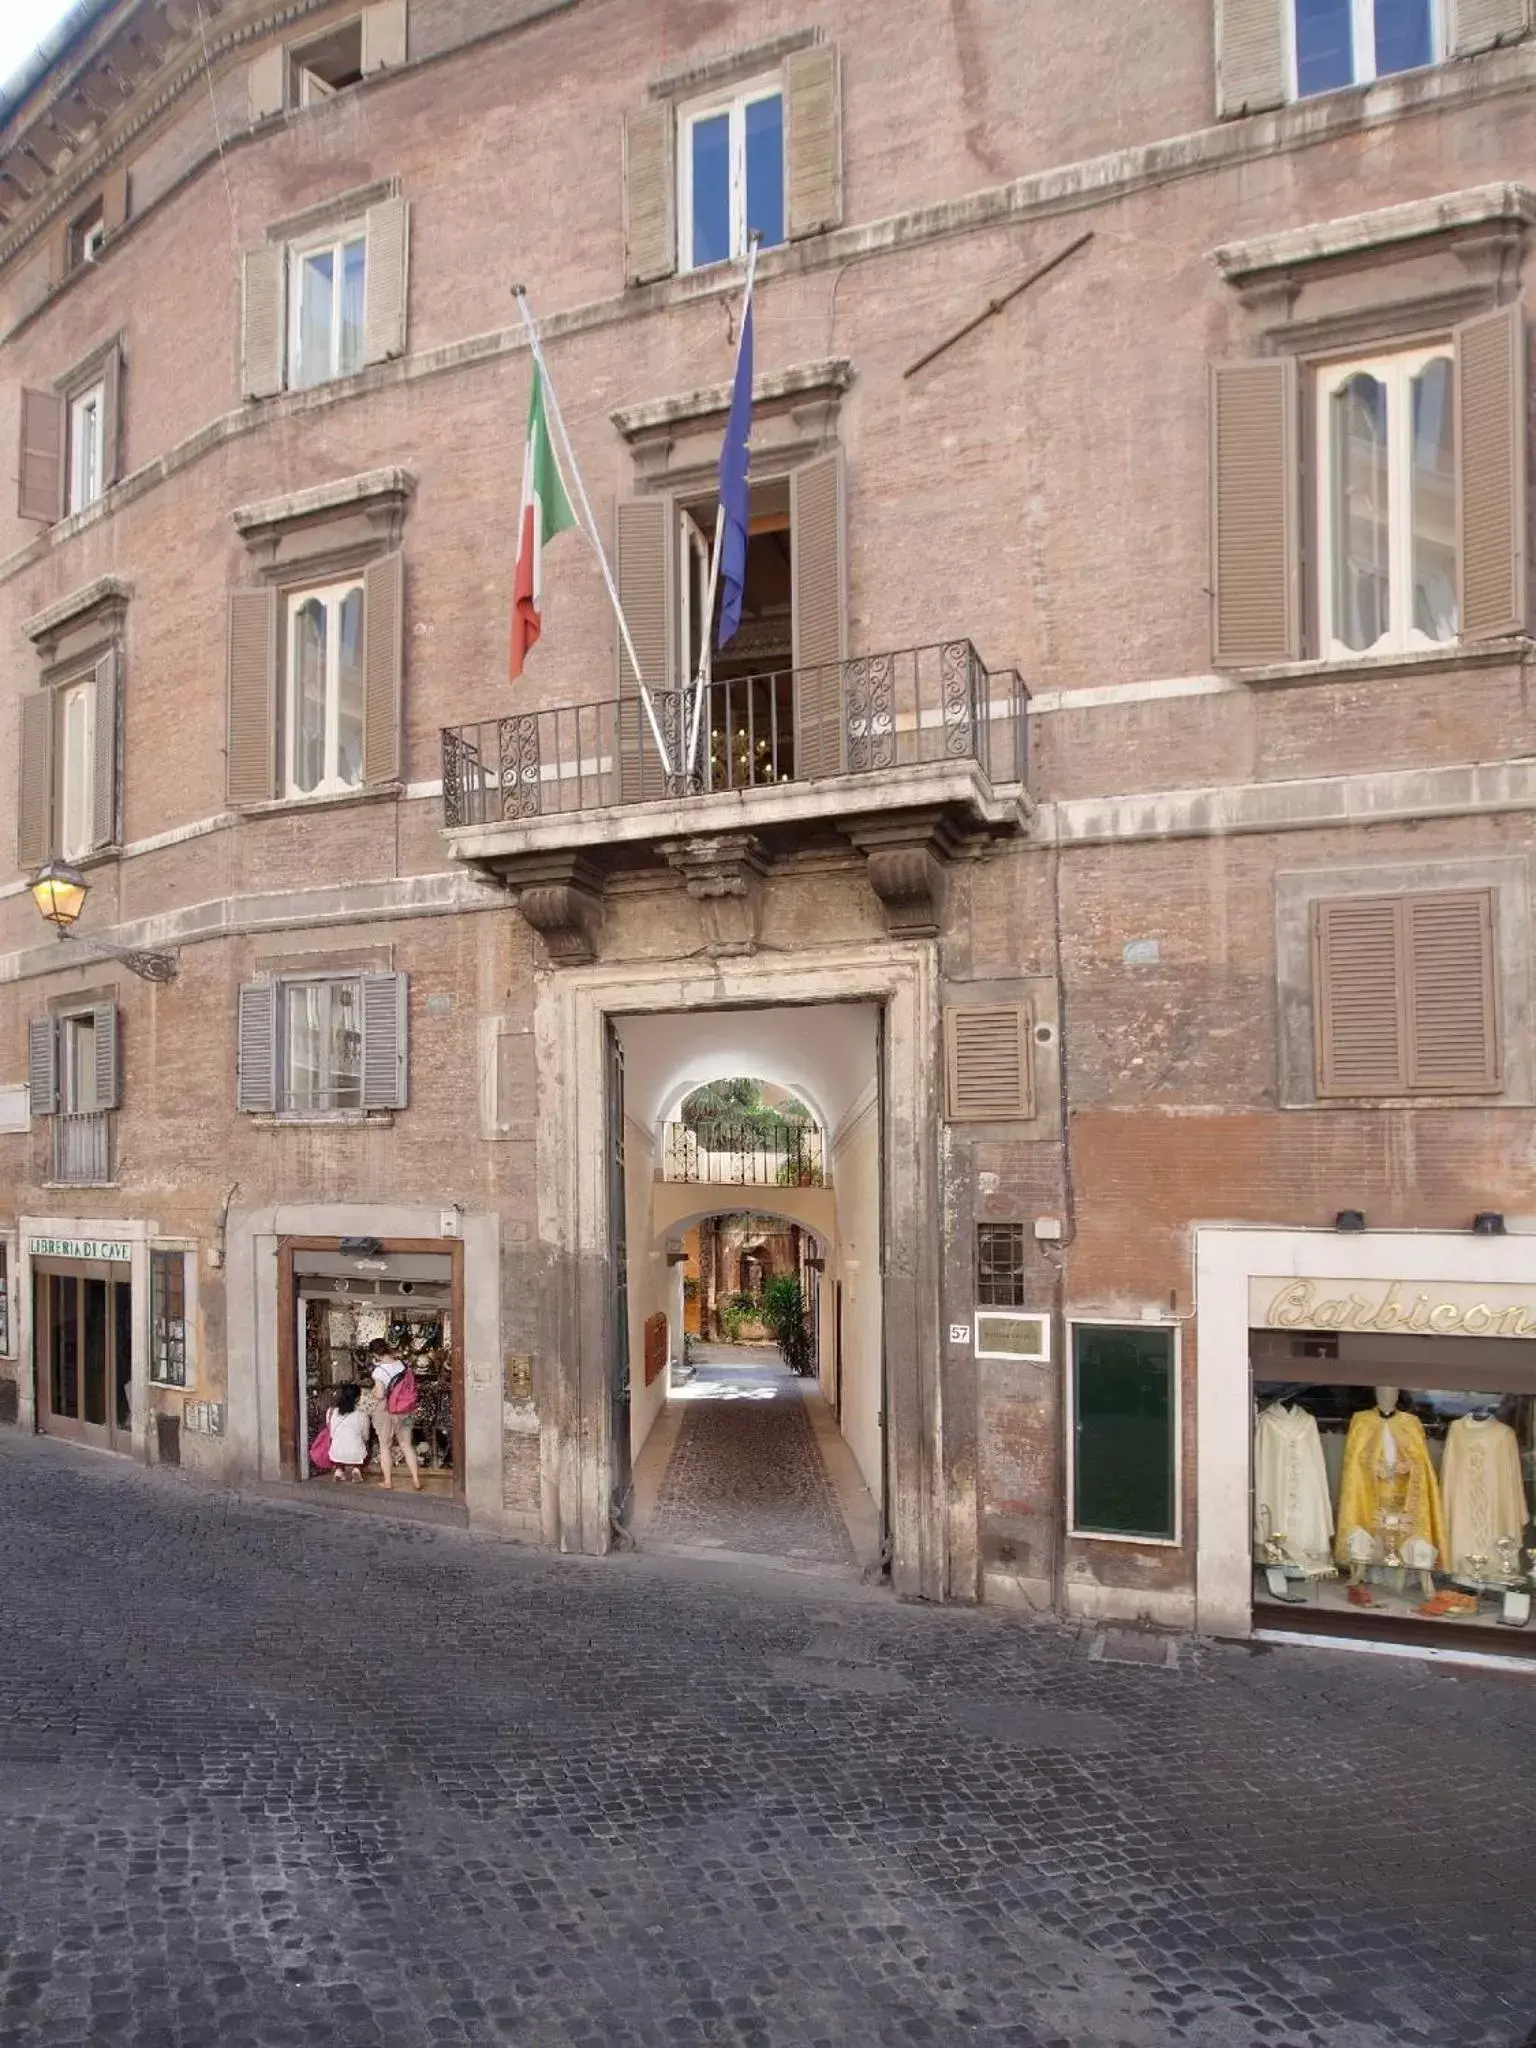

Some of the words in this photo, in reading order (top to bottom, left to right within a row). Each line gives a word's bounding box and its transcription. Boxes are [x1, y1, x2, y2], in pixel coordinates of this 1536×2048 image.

[31, 1239, 80, 1255] LIBRERIA
[84, 1242, 96, 1257] DI
[101, 1243, 130, 1260] CAVE
[952, 1326, 968, 1339] 57
